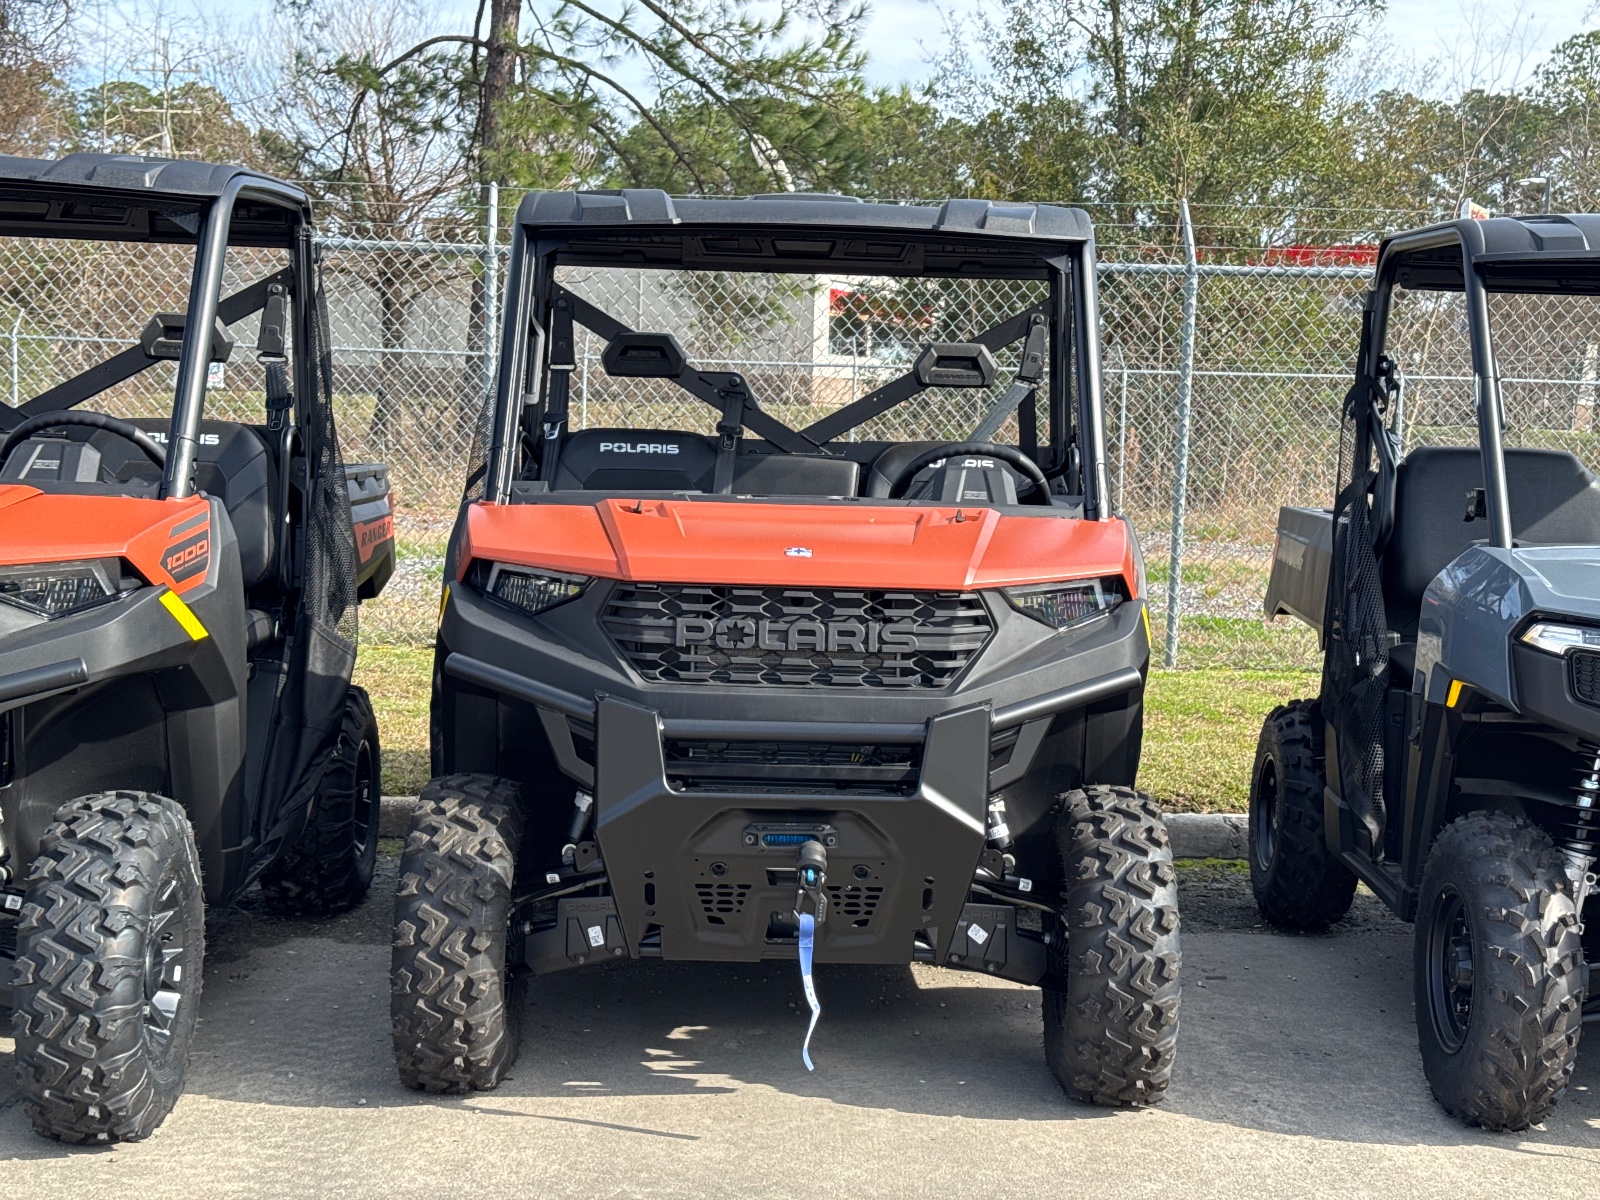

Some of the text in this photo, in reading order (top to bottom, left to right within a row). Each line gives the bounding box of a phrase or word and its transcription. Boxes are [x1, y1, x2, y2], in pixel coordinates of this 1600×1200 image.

[600, 442, 680, 455] POLARIS
[166, 539, 208, 570] 1000
[676, 617, 918, 653] POLARIS
